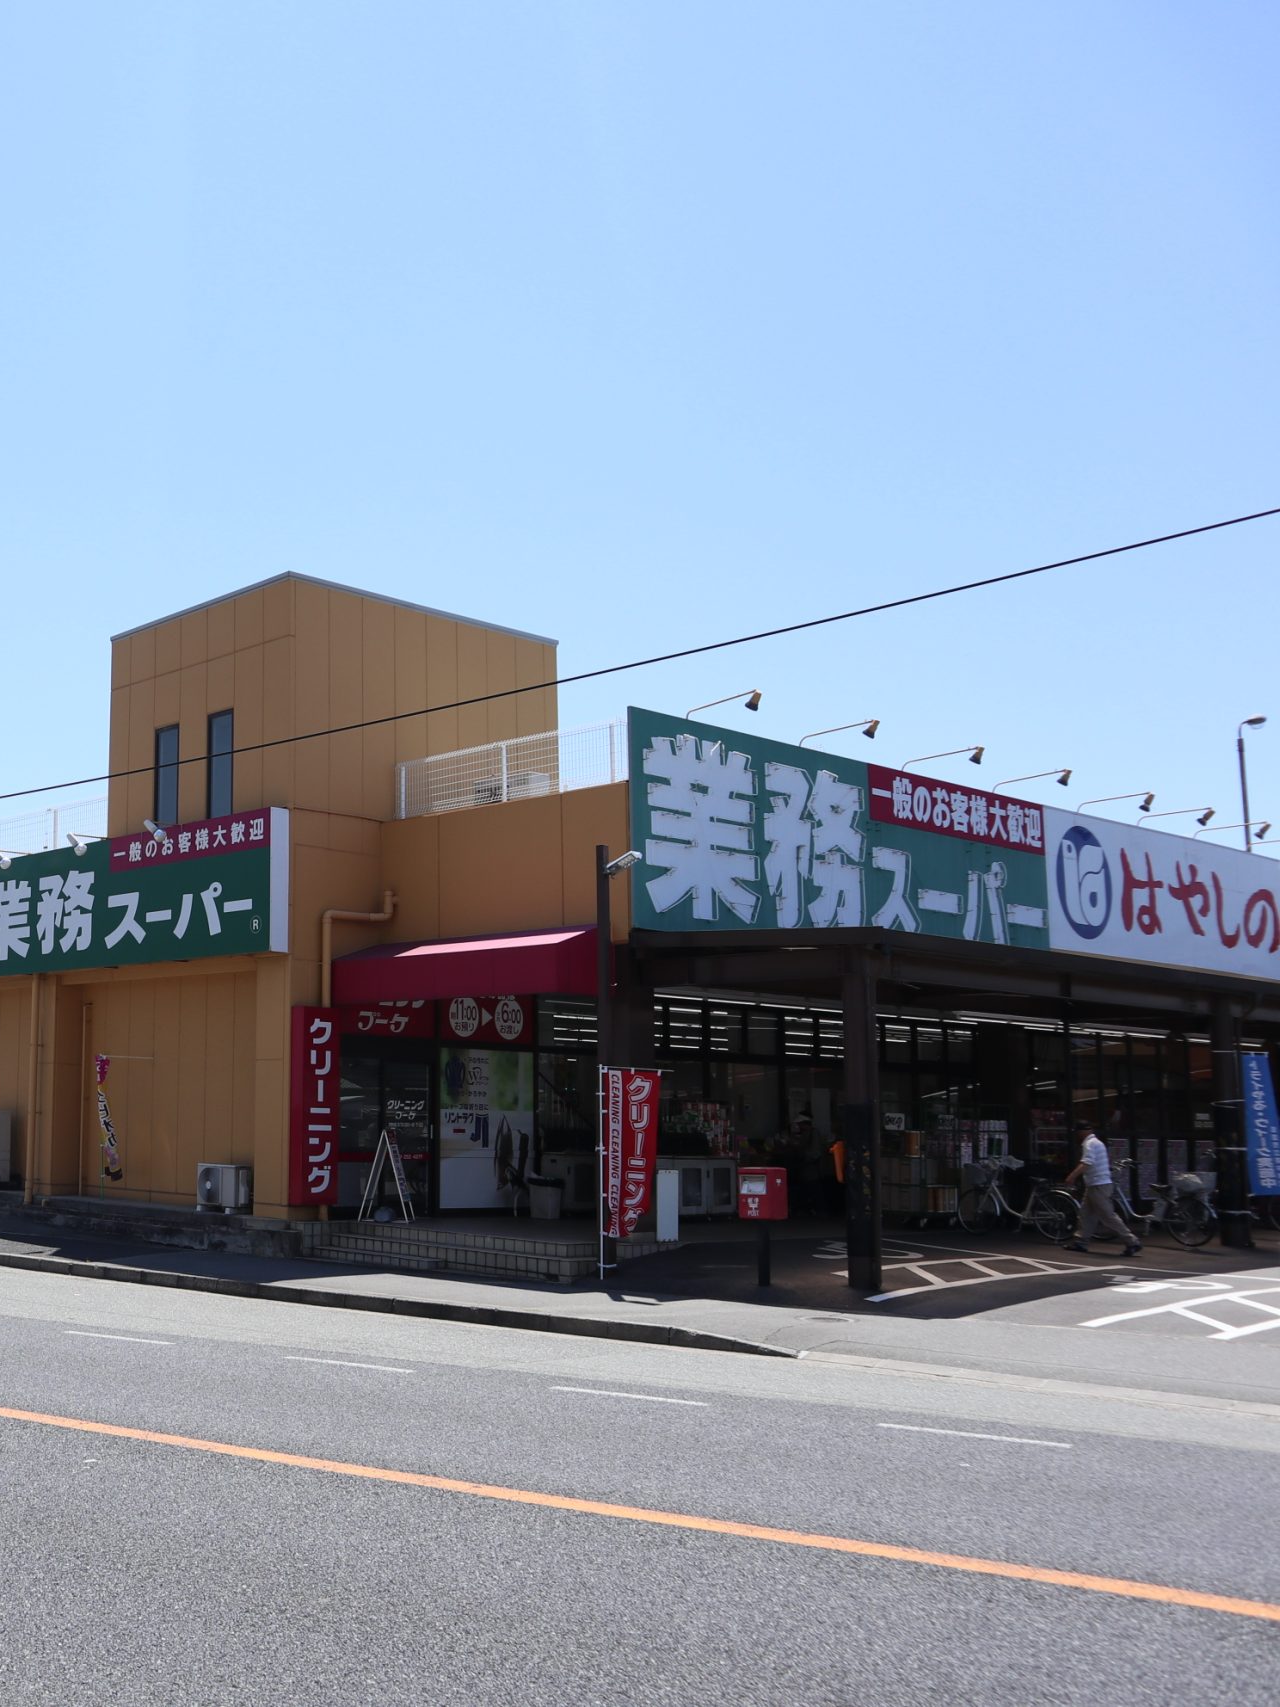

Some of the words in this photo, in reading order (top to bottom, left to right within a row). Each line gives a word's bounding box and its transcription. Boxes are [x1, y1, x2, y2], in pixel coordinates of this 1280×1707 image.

[114, 818, 264, 862] 一般のお客様大歓迎
[643, 733, 1047, 944] 業務スーパー
[872, 776, 1042, 848] 一般のお客様大歓迎
[1121, 847, 1280, 953] はやしの
[307, 1017, 332, 1194] クリーニング
[387, 1100, 425, 1110] クリーニング
[611, 1074, 620, 1125] CLEANING
[611, 1130, 620, 1179] CLEANING
[622, 1074, 652, 1233] クリーニング
[610, 1184, 619, 1236] CLEANING
